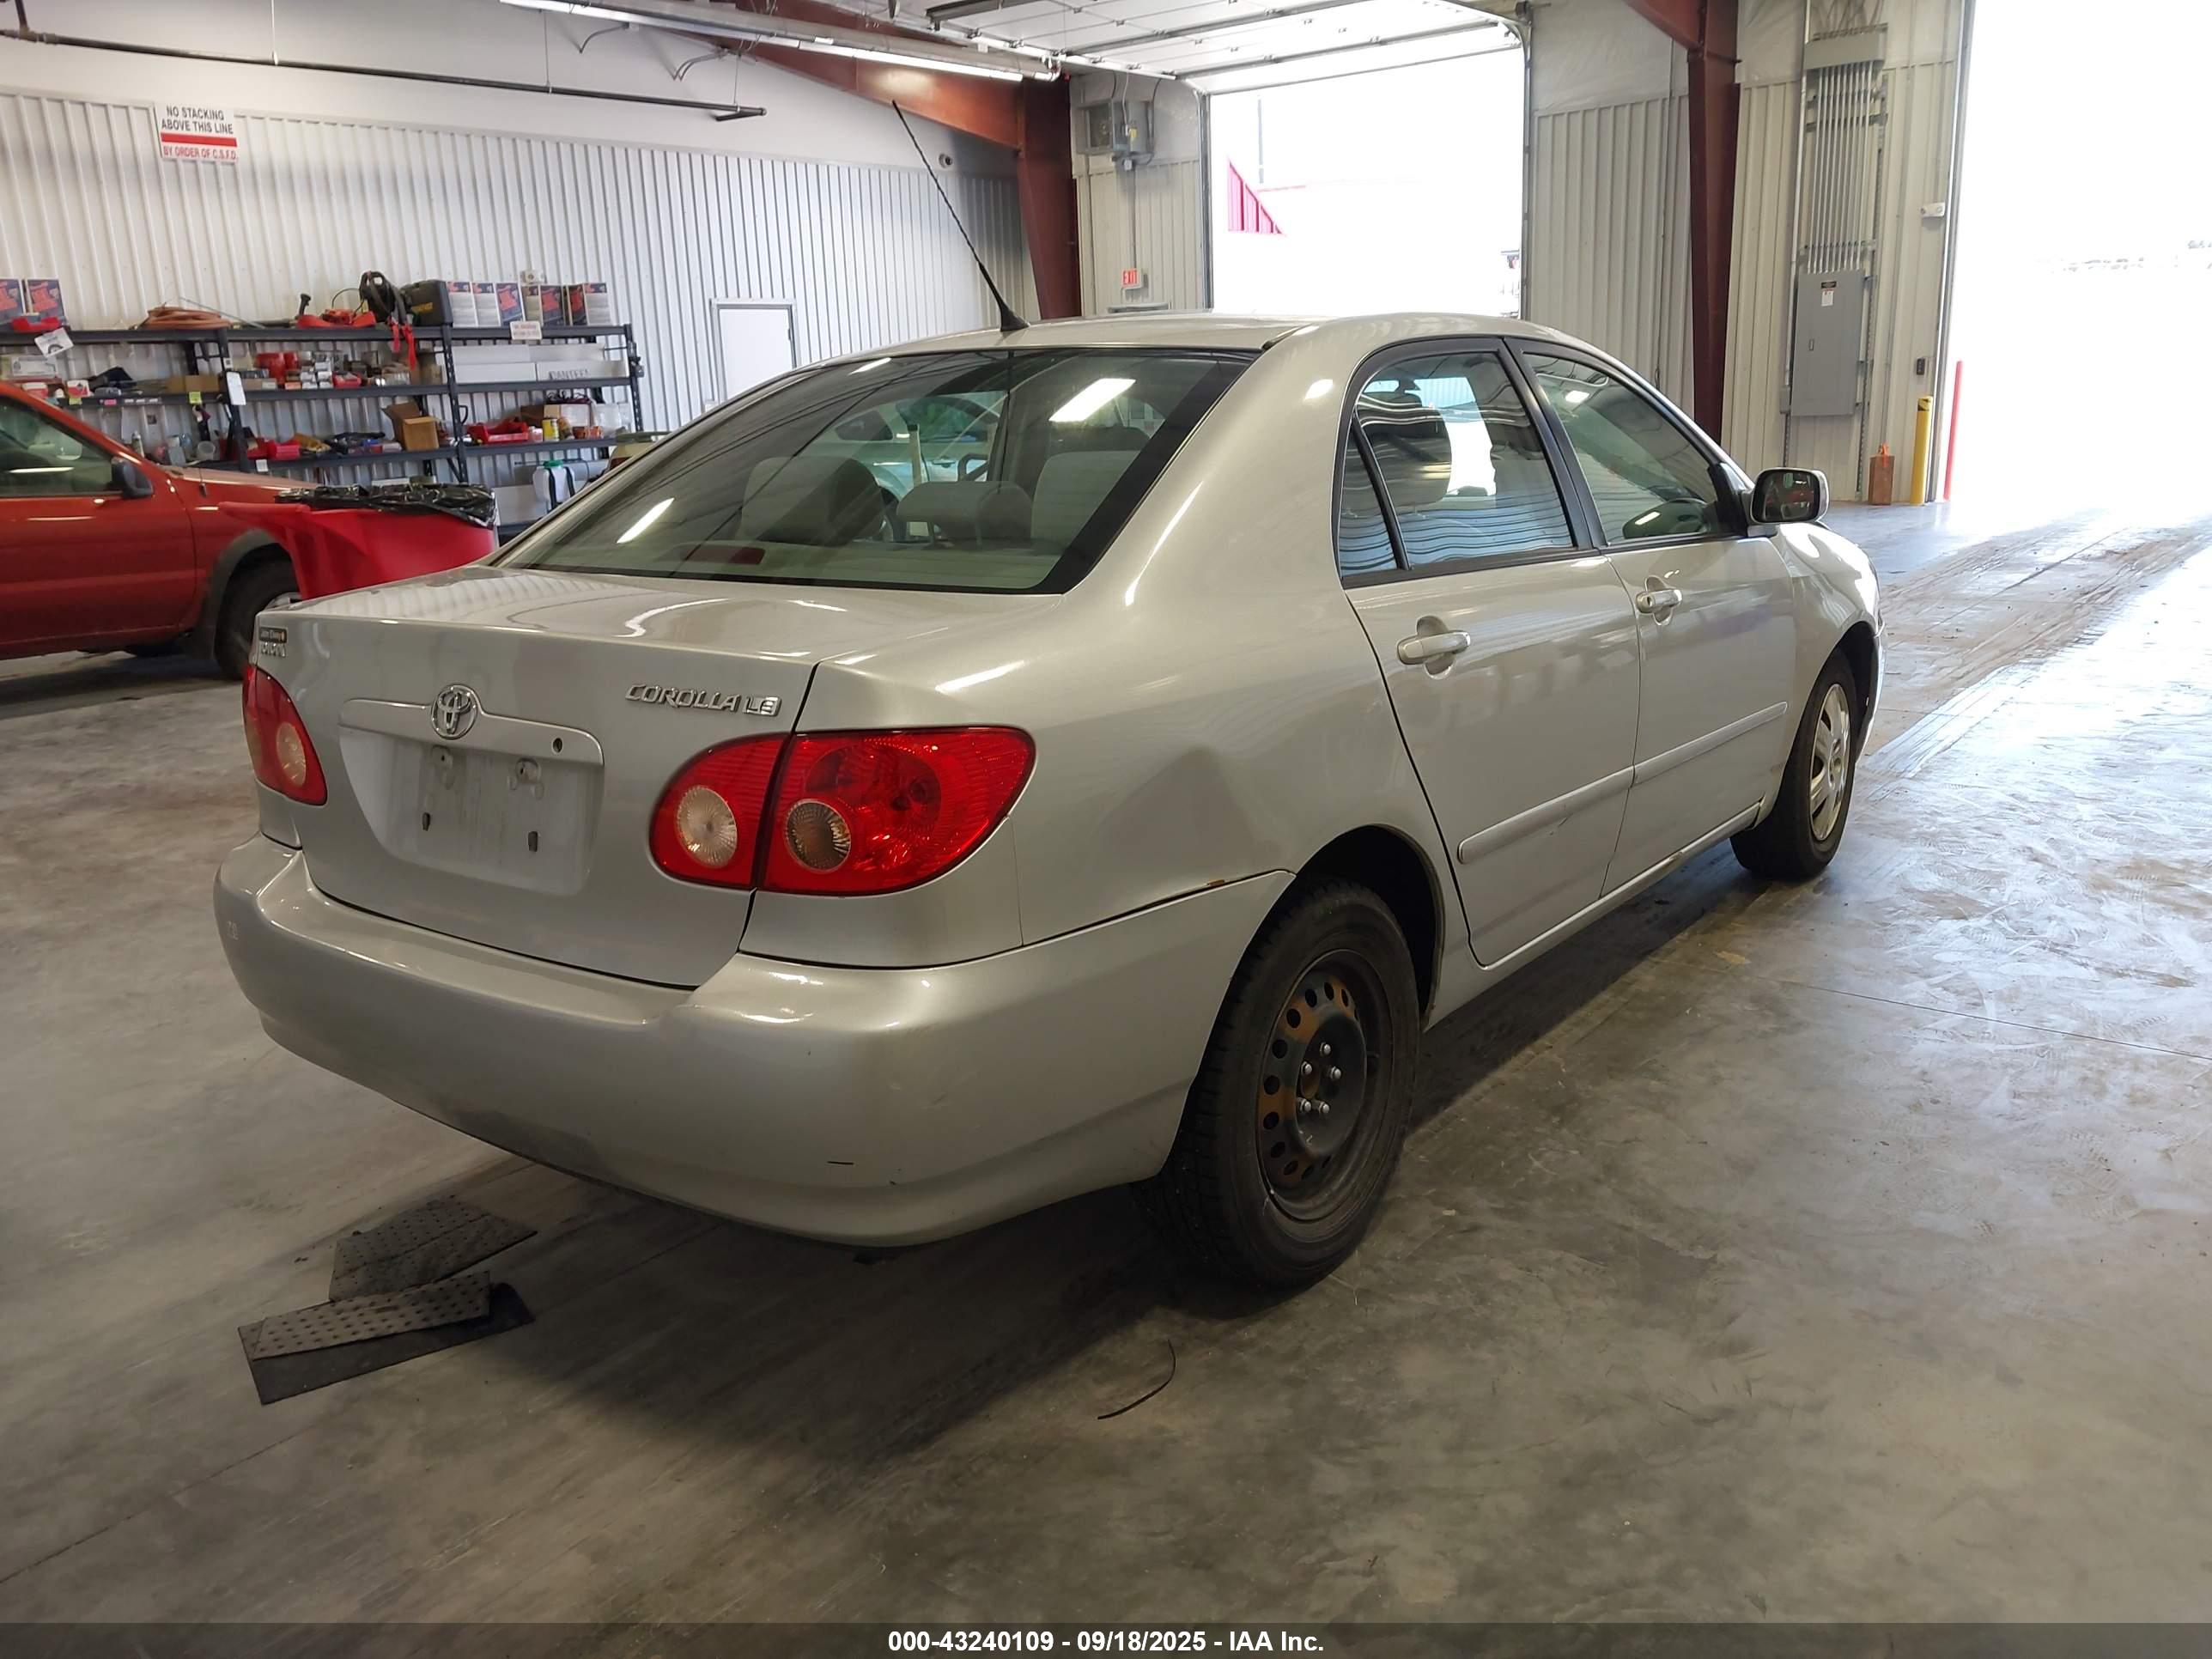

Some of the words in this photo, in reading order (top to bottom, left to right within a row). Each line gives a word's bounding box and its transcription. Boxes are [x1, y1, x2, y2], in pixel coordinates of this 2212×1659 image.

[166, 105, 179, 118] NO
[181, 106, 225, 121] STACKING
[161, 118, 191, 131] ABOVE
[192, 121, 212, 133] THIS
[214, 122, 234, 135] LINE
[163, 145, 173, 156] BY
[174, 146, 199, 158] ORDER
[201, 148, 210, 159] OF
[1122, 270, 1138, 285] EXIT
[625, 684, 741, 712] COROLLA
[742, 696, 782, 717] LE
